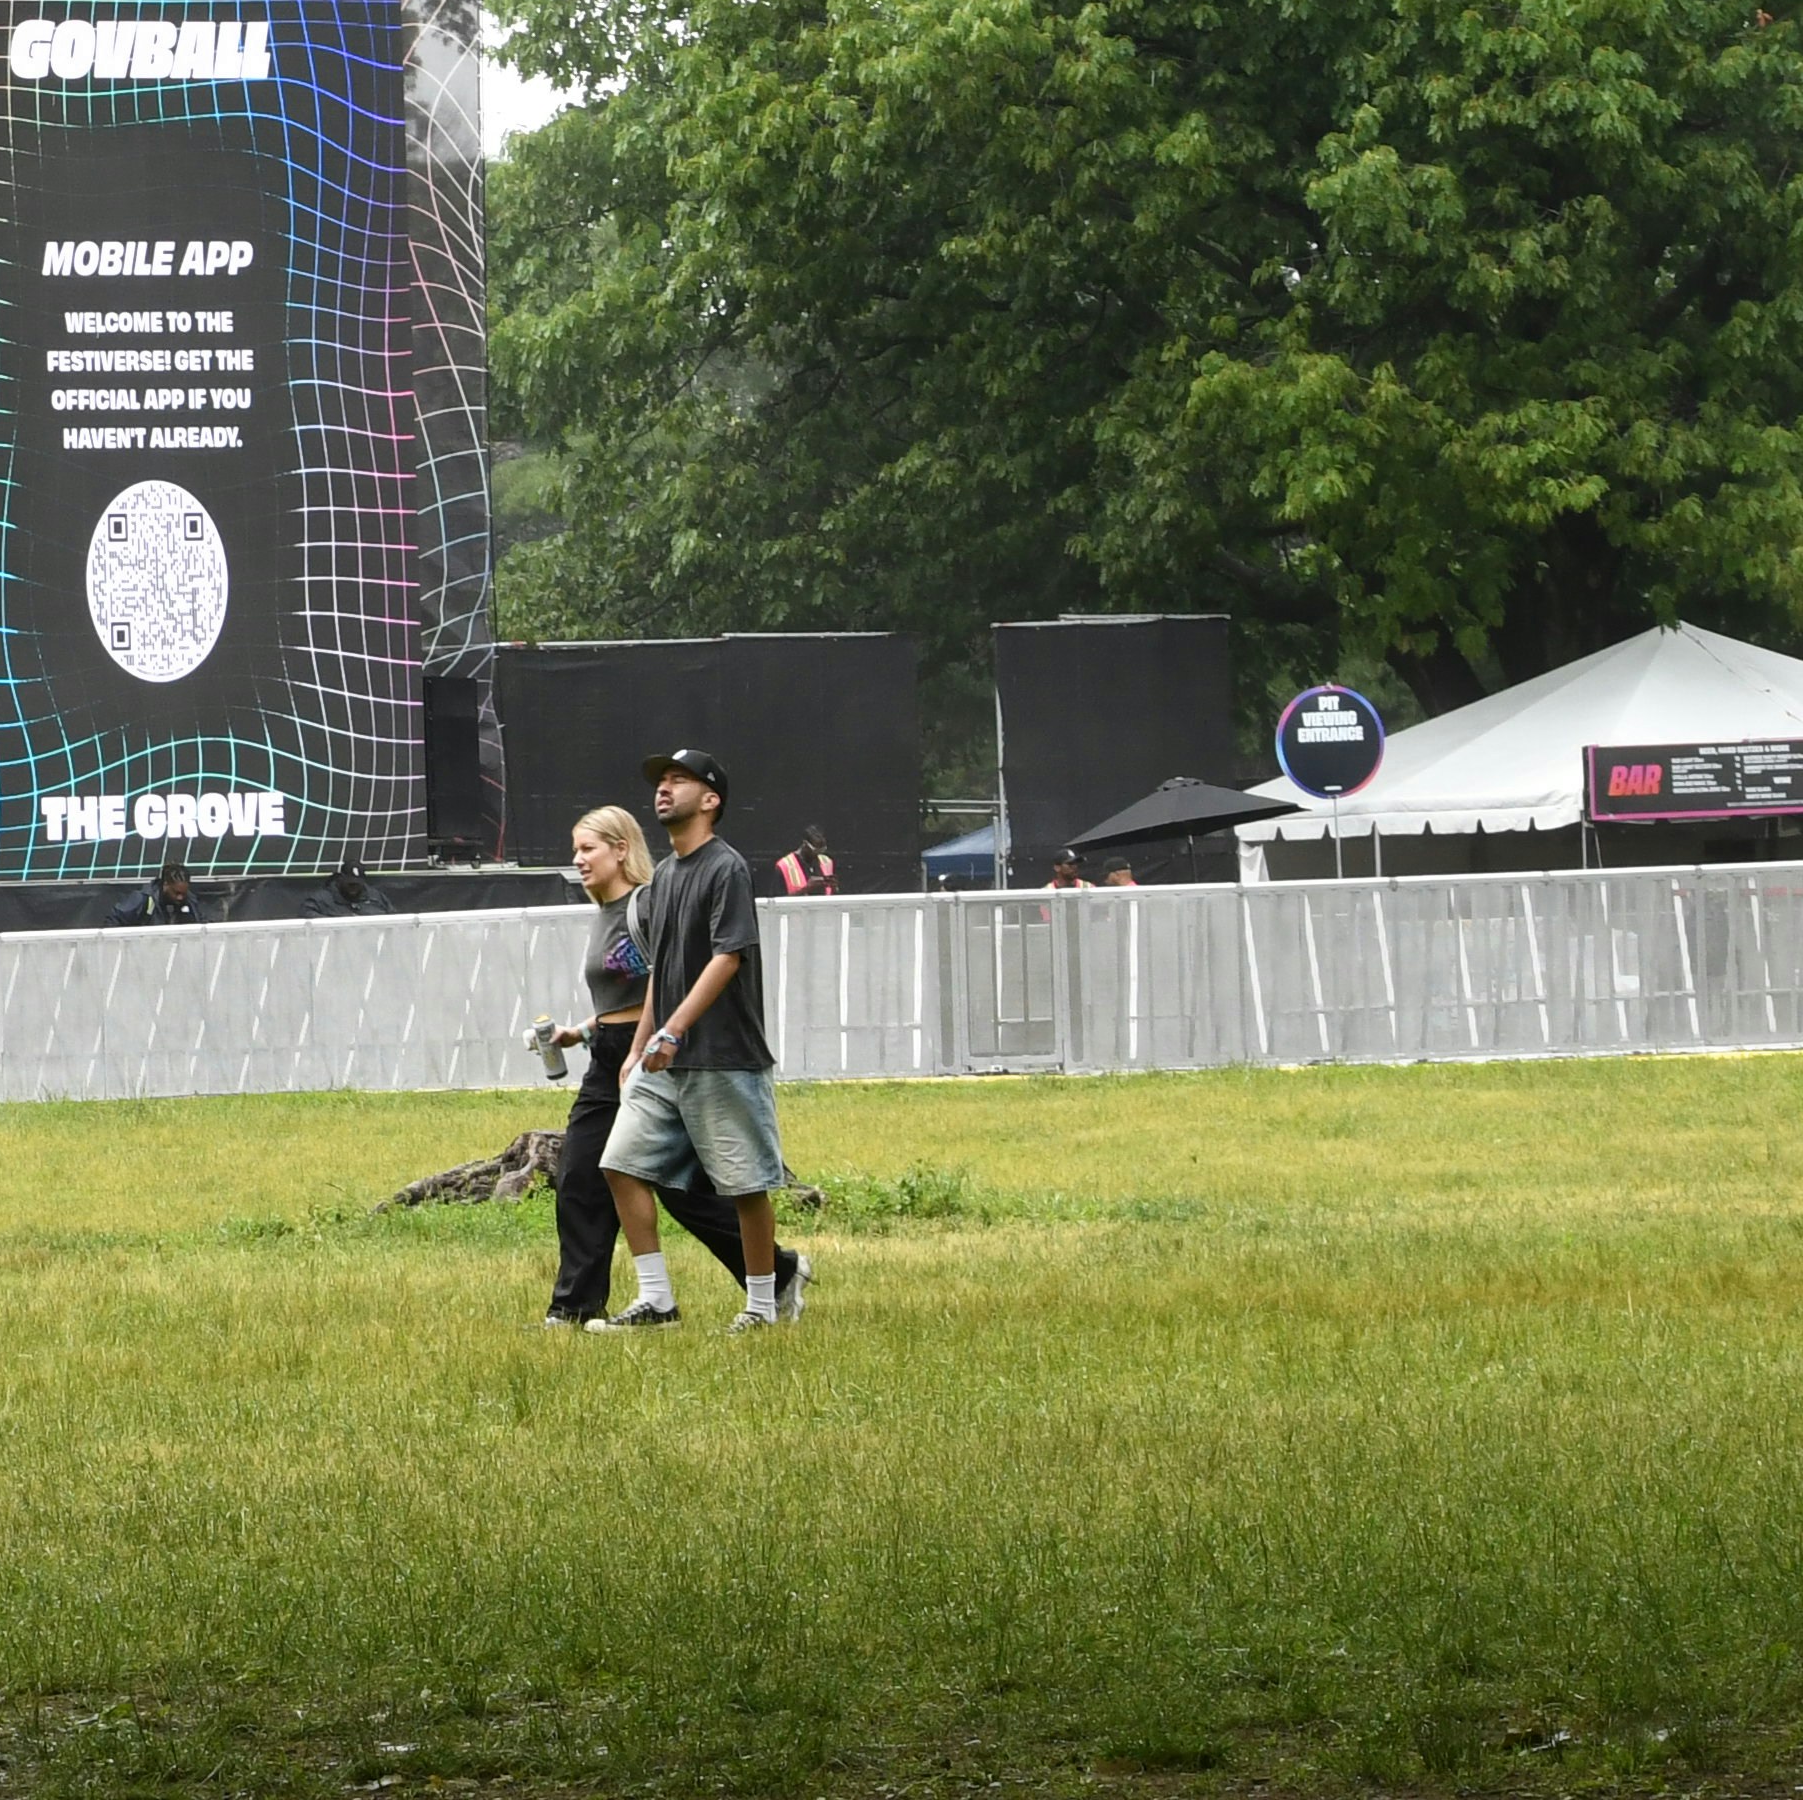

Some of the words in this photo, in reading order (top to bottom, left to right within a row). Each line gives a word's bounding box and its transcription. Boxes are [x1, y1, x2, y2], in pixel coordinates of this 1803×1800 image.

[9, 19, 271, 80] GOVBALL
[42, 241, 175, 277] MOBILE
[179, 241, 254, 276] APP
[64, 311, 163, 334] WELCOME
[166, 311, 191, 333] TO
[194, 311, 233, 332] THE
[46, 350, 171, 372] FESTIVERSE!
[174, 350, 214, 371] GET
[217, 350, 254, 371] THE
[51, 389, 140, 410] OFFICIAL
[143, 389, 184, 409] APP
[187, 389, 207, 409] IF
[209, 389, 251, 409] YOU
[62, 428, 147, 449] HAVEN'T
[148, 428, 243, 448] ALREADY.
[1318, 695, 1340, 711] PIT
[1301, 710, 1358, 727] VIEWING
[1297, 726, 1365, 743] ENTRANCE
[1608, 764, 1663, 796] BAR
[41, 795, 126, 841] THE
[134, 791, 285, 840] GROVE
